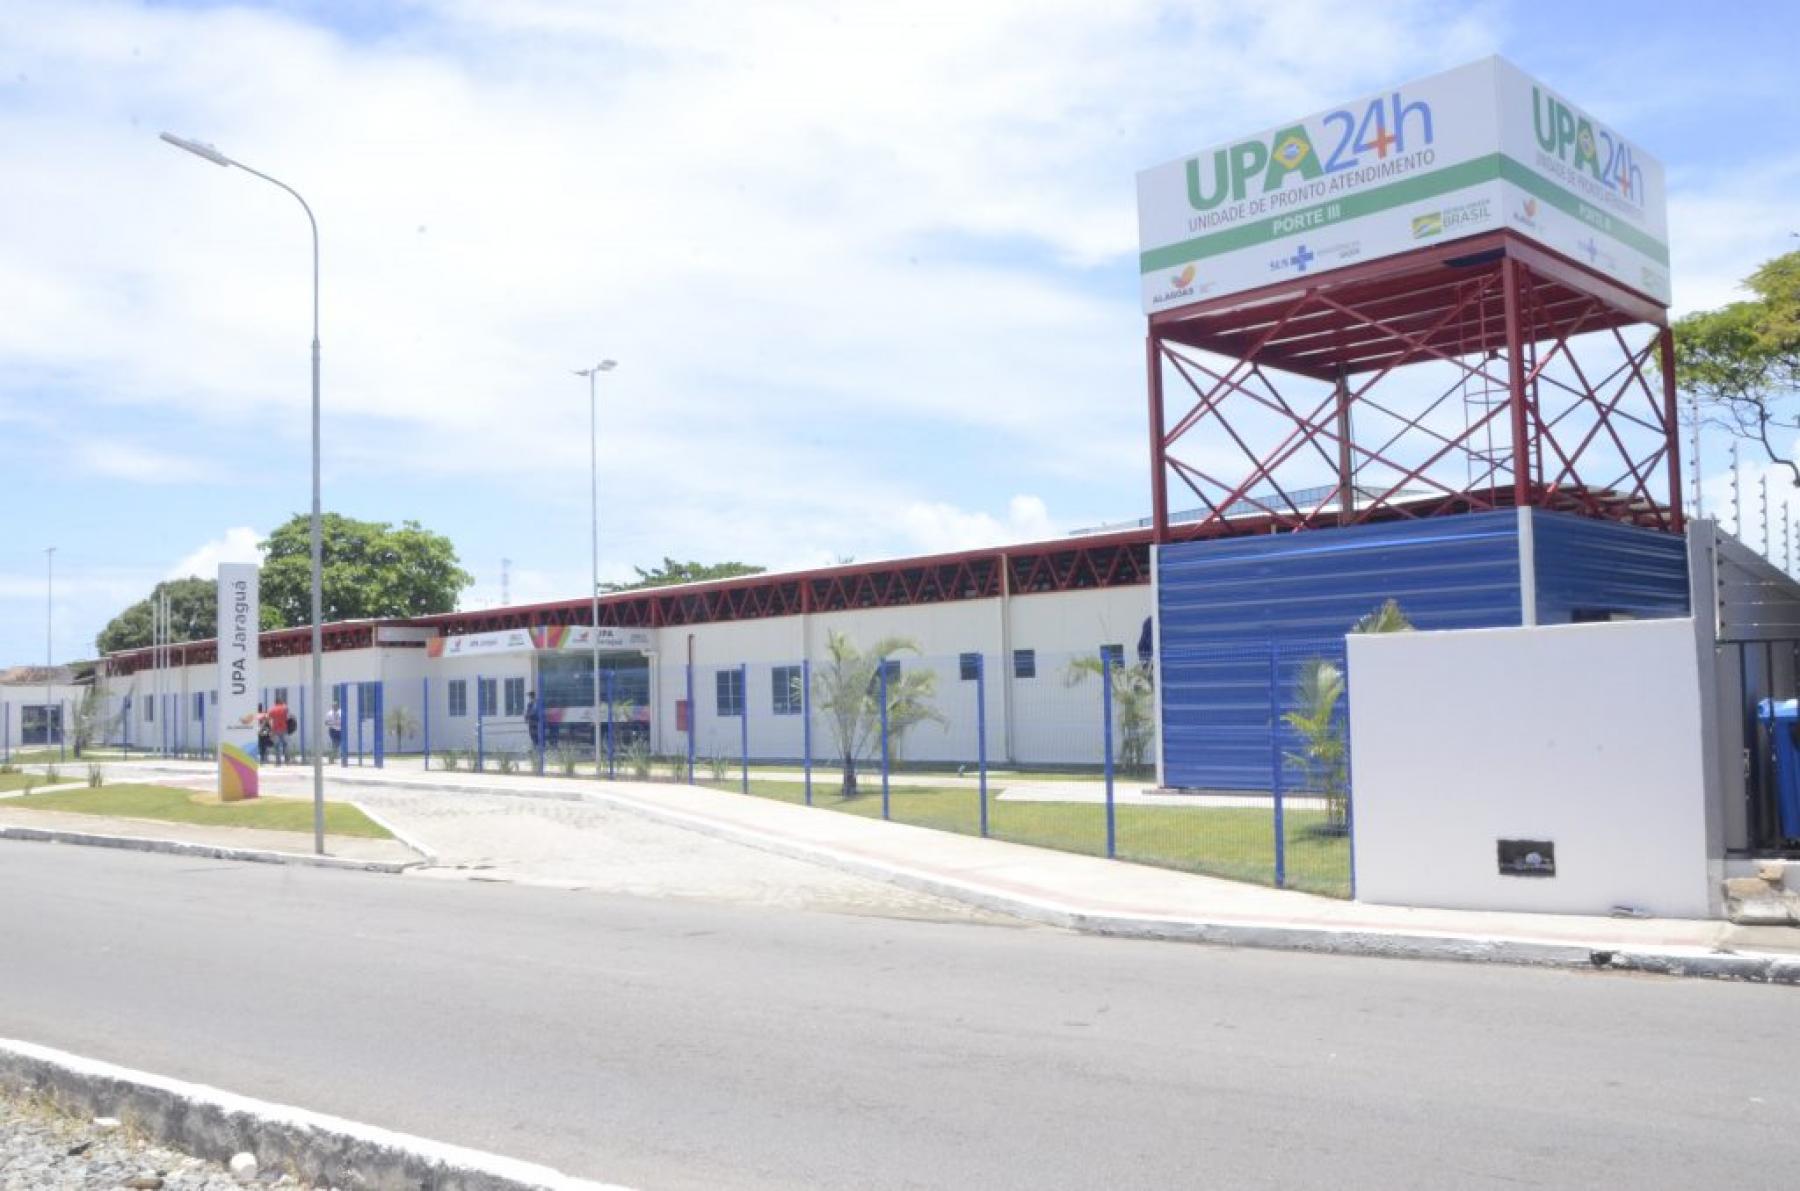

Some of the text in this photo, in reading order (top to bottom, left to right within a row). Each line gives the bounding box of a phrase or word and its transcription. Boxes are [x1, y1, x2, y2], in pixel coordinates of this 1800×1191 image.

[1185, 92, 1434, 211] UPA 24h
[1532, 86, 1600, 183] UPA
[1189, 148, 1436, 233] UNIDADE DE PRONTO ATENDIMENTO
[1272, 208, 1323, 236] PORTE
[231, 580, 250, 695] UPA Jaraguá
